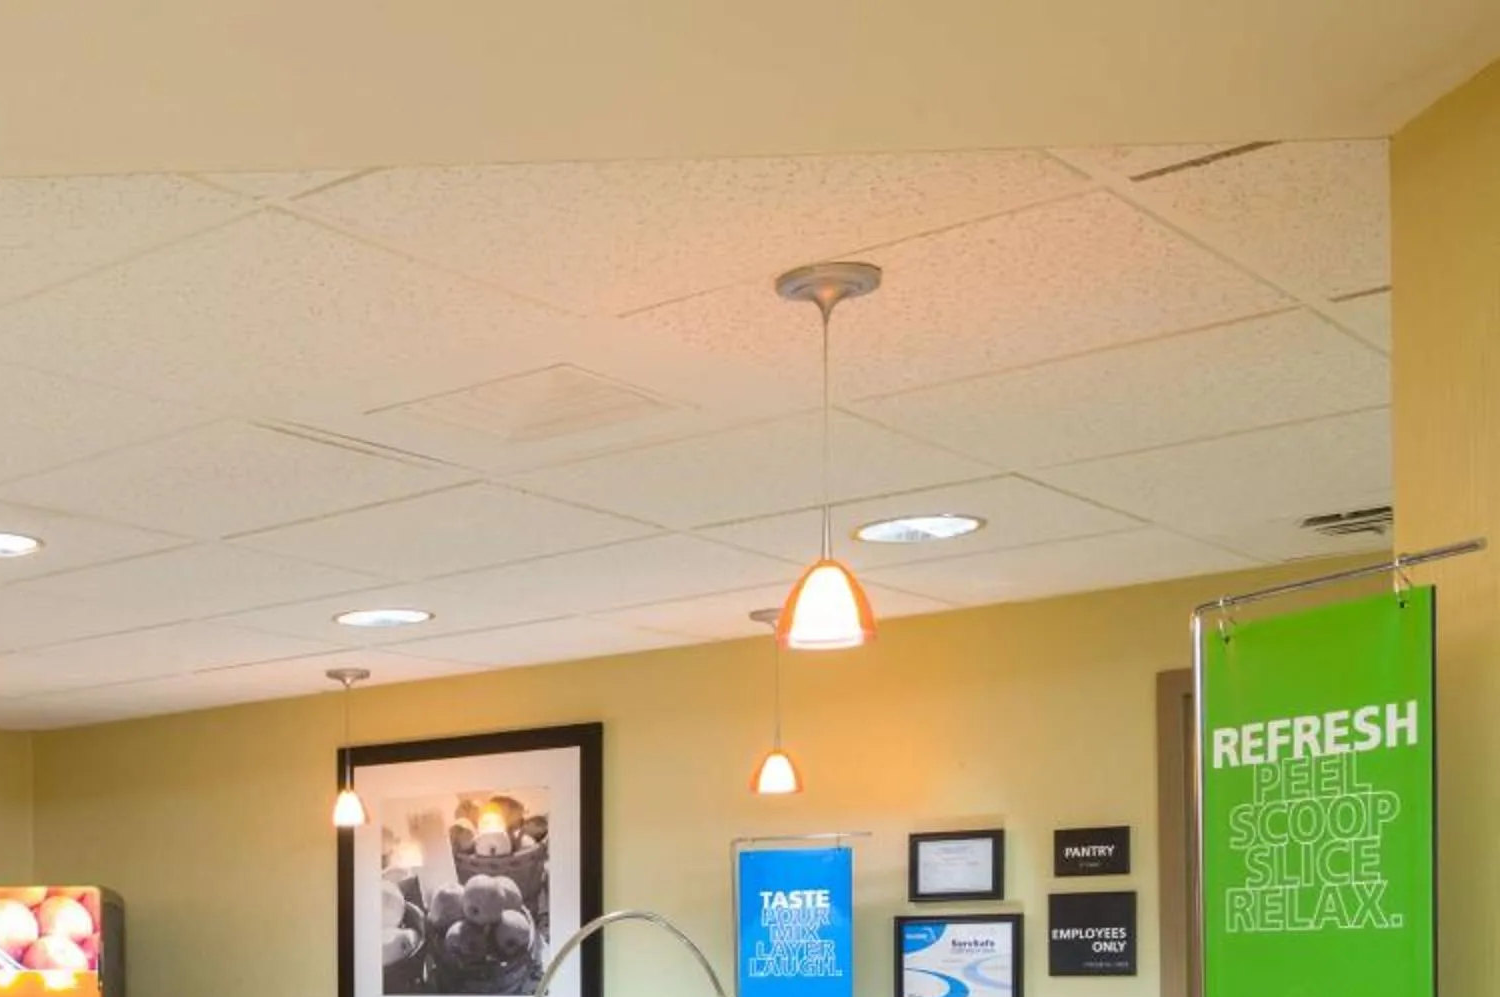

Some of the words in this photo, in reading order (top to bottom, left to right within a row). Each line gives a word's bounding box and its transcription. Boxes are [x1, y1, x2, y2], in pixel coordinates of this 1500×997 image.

[1213, 700, 1418, 769] REFRESH
[1253, 748, 1372, 806] PEEL
[1229, 790, 1401, 849] SCOOP
[1064, 845, 1115, 858] PANTRY
[1245, 837, 1381, 891] SLICE
[758, 889, 831, 909] TASTE
[1225, 879, 1404, 933] RELAX.
[761, 907, 831, 927] POUR
[769, 923, 822, 943] MIX
[1051, 927, 1127, 940] EMPLOYEES
[755, 939, 836, 961] LAYER
[1092, 941, 1127, 953] ONLY
